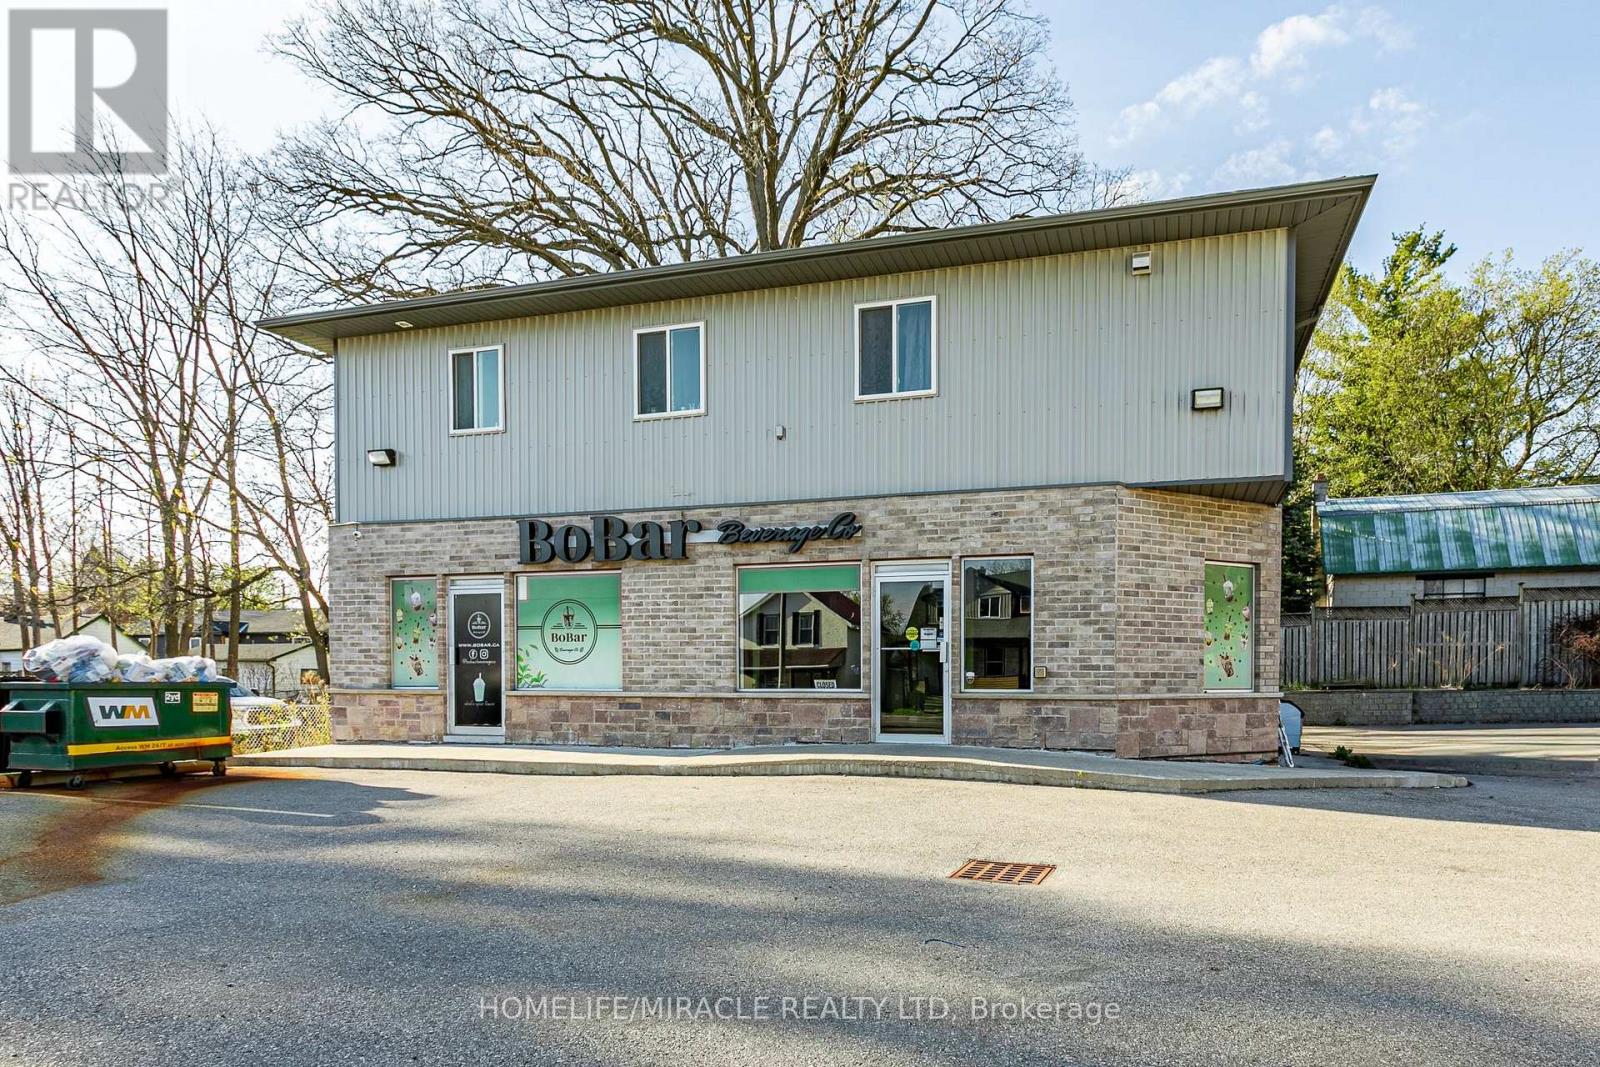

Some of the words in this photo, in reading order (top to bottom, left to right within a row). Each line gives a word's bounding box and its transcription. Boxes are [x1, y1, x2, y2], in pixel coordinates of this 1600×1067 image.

[516, 515, 702, 564] BoBar
[717, 520, 829, 553] Beverage
[826, 512, 862, 539] Co
[551, 632, 588, 643] BoBar
[816, 681, 835, 689] CLOSED
[98, 705, 152, 720] WM
